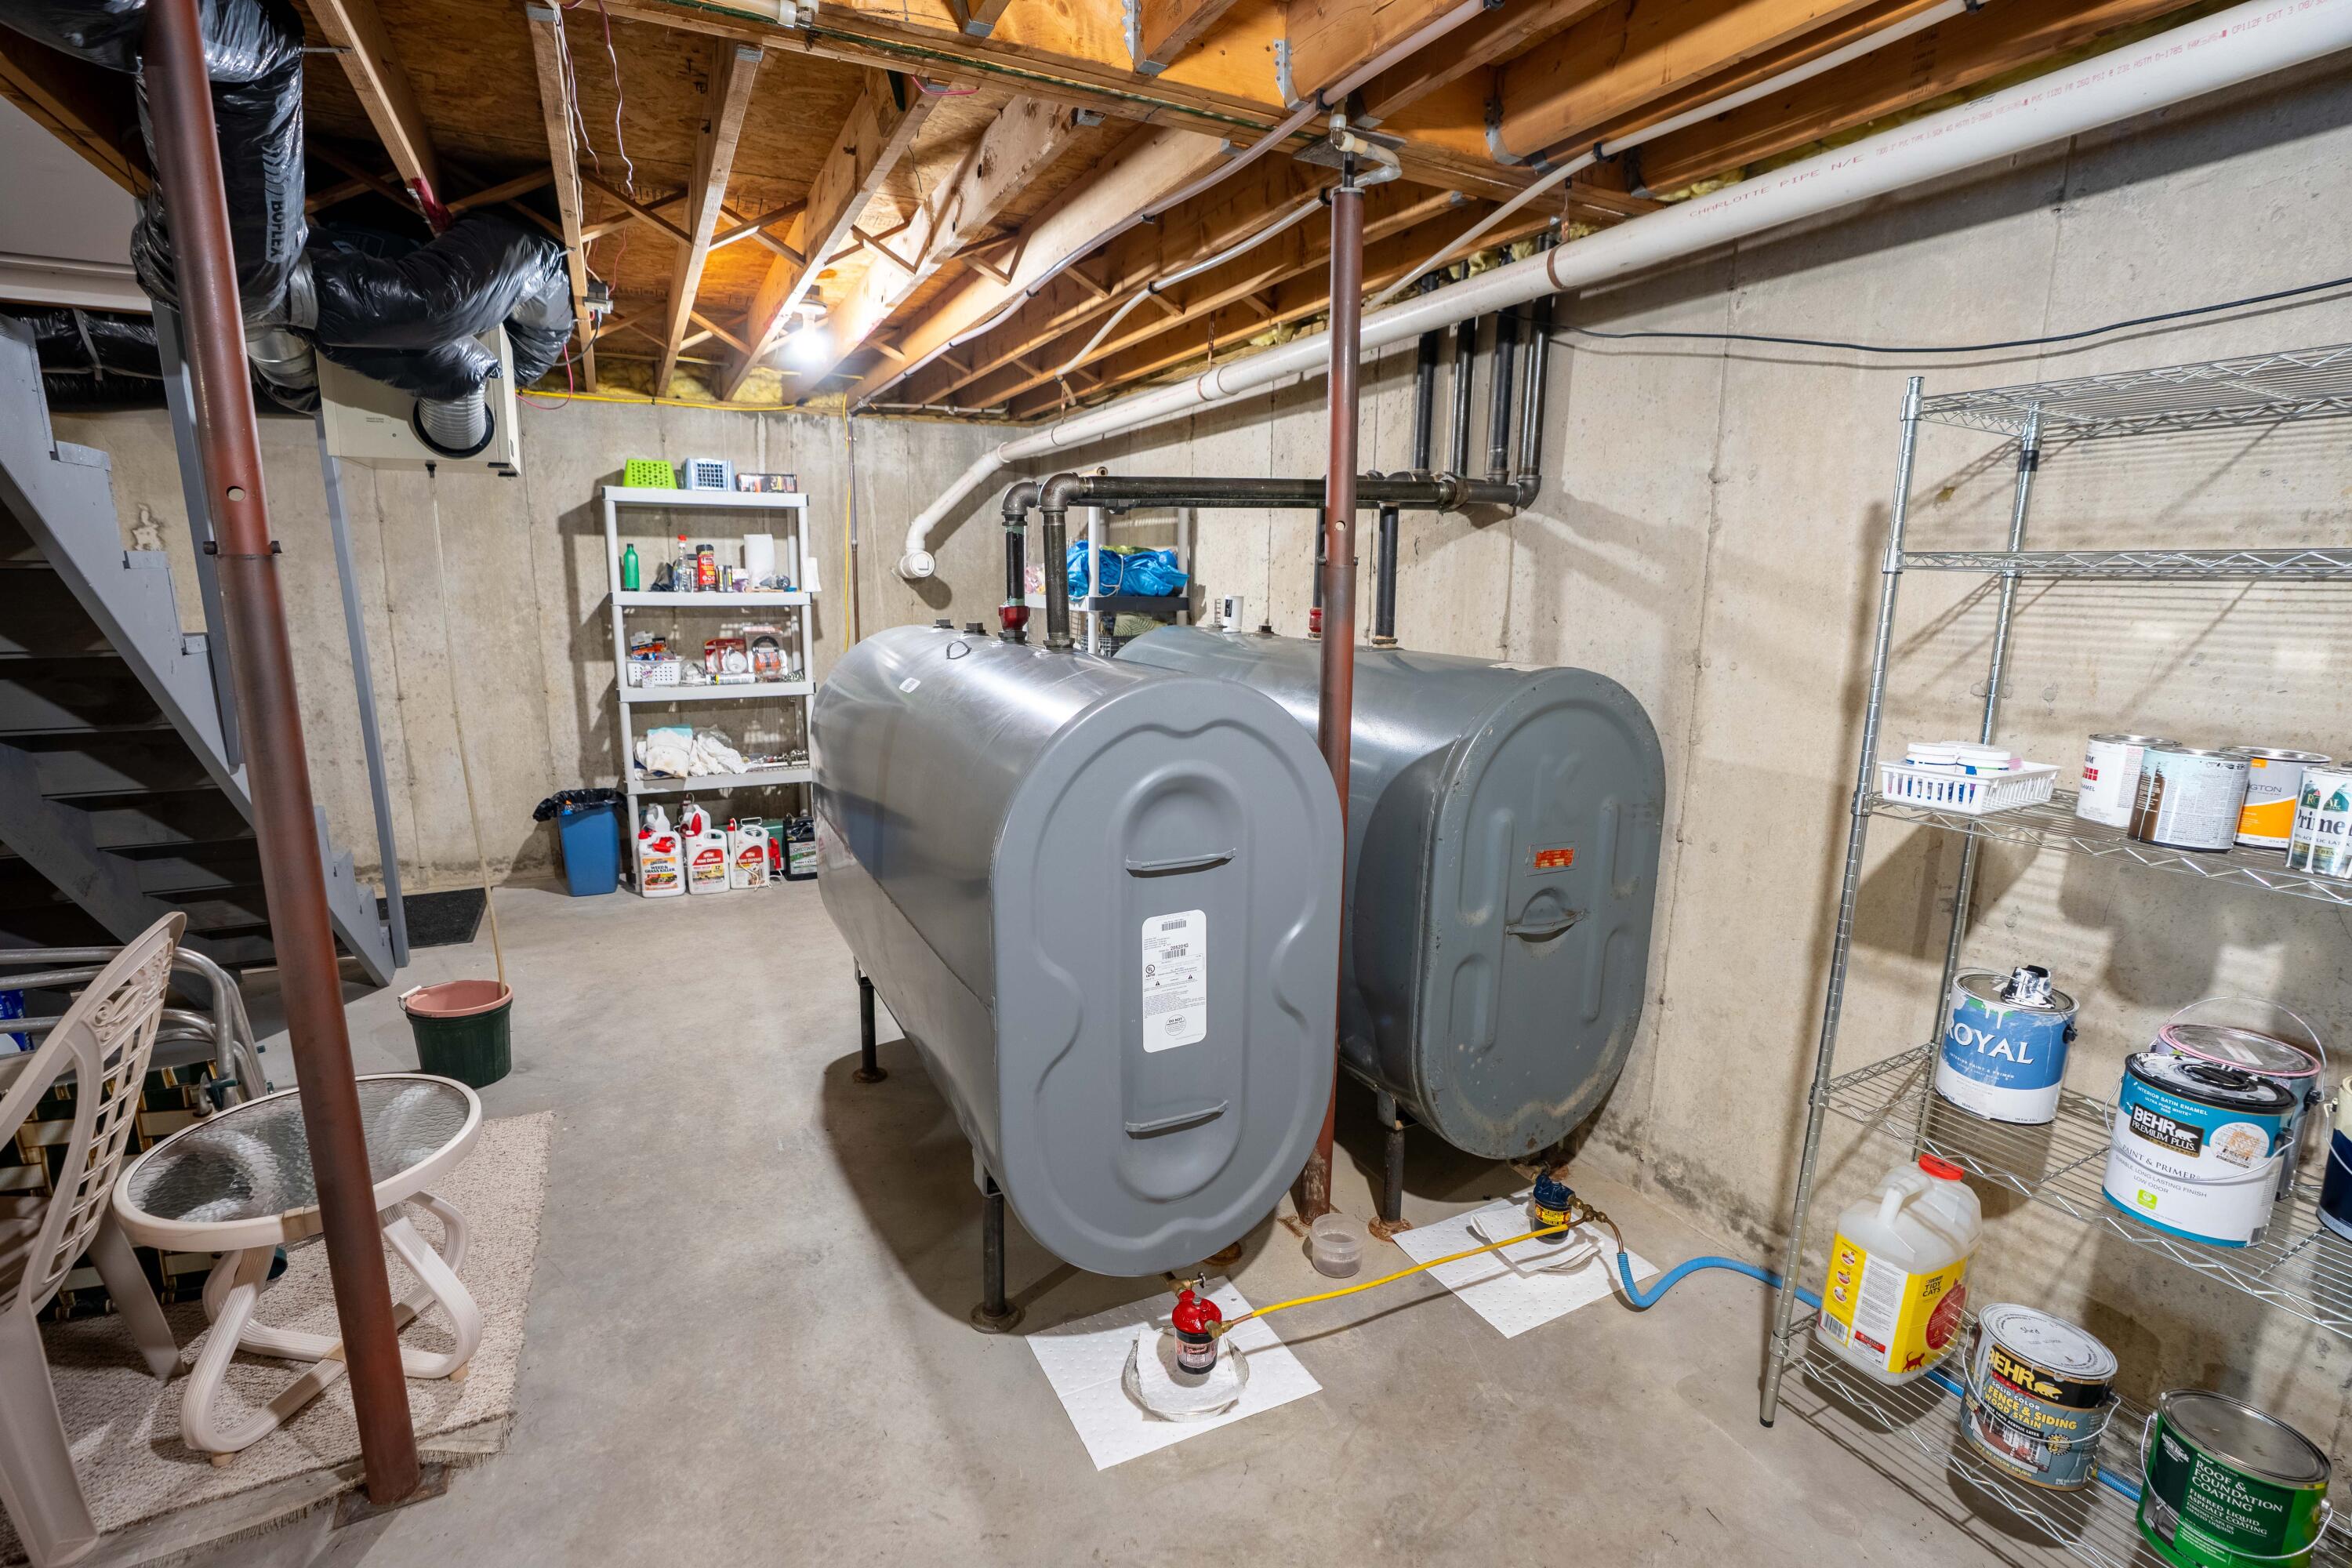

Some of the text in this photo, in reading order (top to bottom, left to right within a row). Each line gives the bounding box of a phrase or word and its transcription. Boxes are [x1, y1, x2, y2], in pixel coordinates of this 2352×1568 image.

[2267, 9, 2283, 23] EXT
[2133, 56, 2152, 69] ASTM
[1690, 155, 1864, 218] CHARLOTTE PIPE N/E
[2137, 1086, 2208, 1116] INTERIOR SATIN ENAMEL
[2144, 1096, 2158, 1105] ULTRA
[2158, 1102, 2172, 1111] PURE
[2132, 1120, 2168, 1142] PREMIUM
[2133, 1105, 2176, 1136] BEHR
[2122, 1145, 2143, 1160] PAINT
[2146, 1158, 2153, 1167] &
[2155, 1161, 2196, 1179] PRIMER
[2133, 1175, 2169, 1194] LOW ODOR
[2183, 1187, 2207, 1198] FINISH
[1922, 1287, 1940, 1297] CATS
[1925, 1280, 1942, 1291] TIDY
[1985, 1391, 2010, 1414] WOOD
[2013, 1411, 2042, 1428] STAIN
[1988, 1385, 2020, 1411] FENCE
[2022, 1406, 2031, 1417] &
[2033, 1411, 2077, 1430] SIDING
[1992, 1381, 2040, 1411] SOLID COLOR
[2197, 1453, 2214, 1465] ROOF
[2194, 1468, 2283, 1512] FOUNDATION
[2195, 1460, 2246, 1493] ROOF &
[2190, 1488, 2259, 1526] FIBERED LIQUID
[2192, 1476, 2252, 1512] COATING
[2187, 1495, 2267, 1535] ASPHALT COATING
